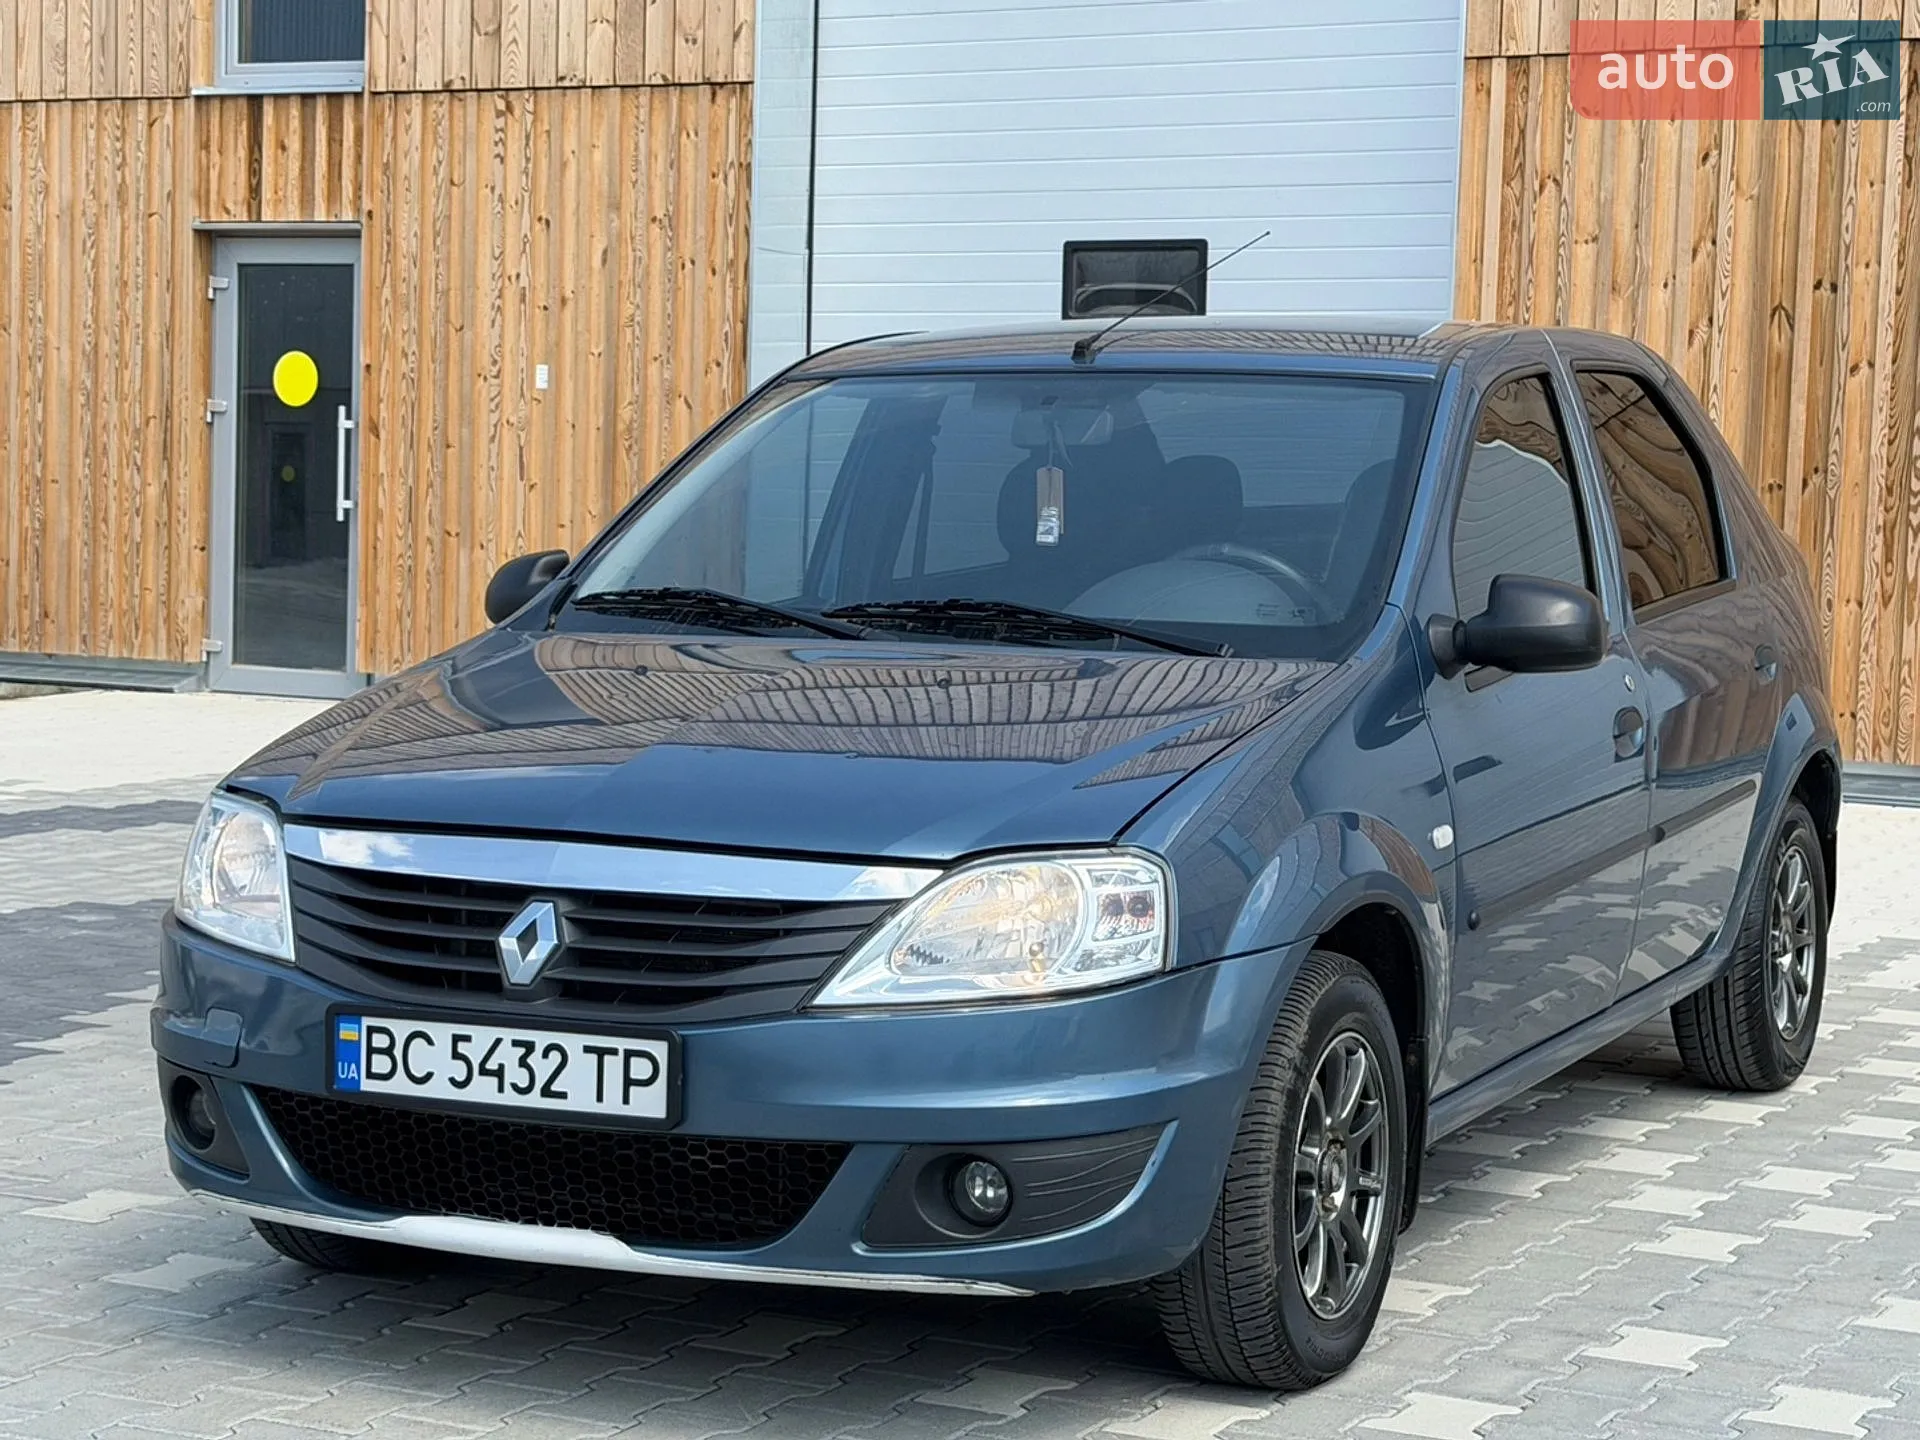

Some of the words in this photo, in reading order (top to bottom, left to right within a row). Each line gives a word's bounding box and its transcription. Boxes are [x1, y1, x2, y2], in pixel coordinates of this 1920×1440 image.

[338, 1061, 359, 1080] UA
[365, 1025, 435, 1085] BC
[448, 1033, 569, 1100] 5432
[583, 1045, 660, 1105] TP
